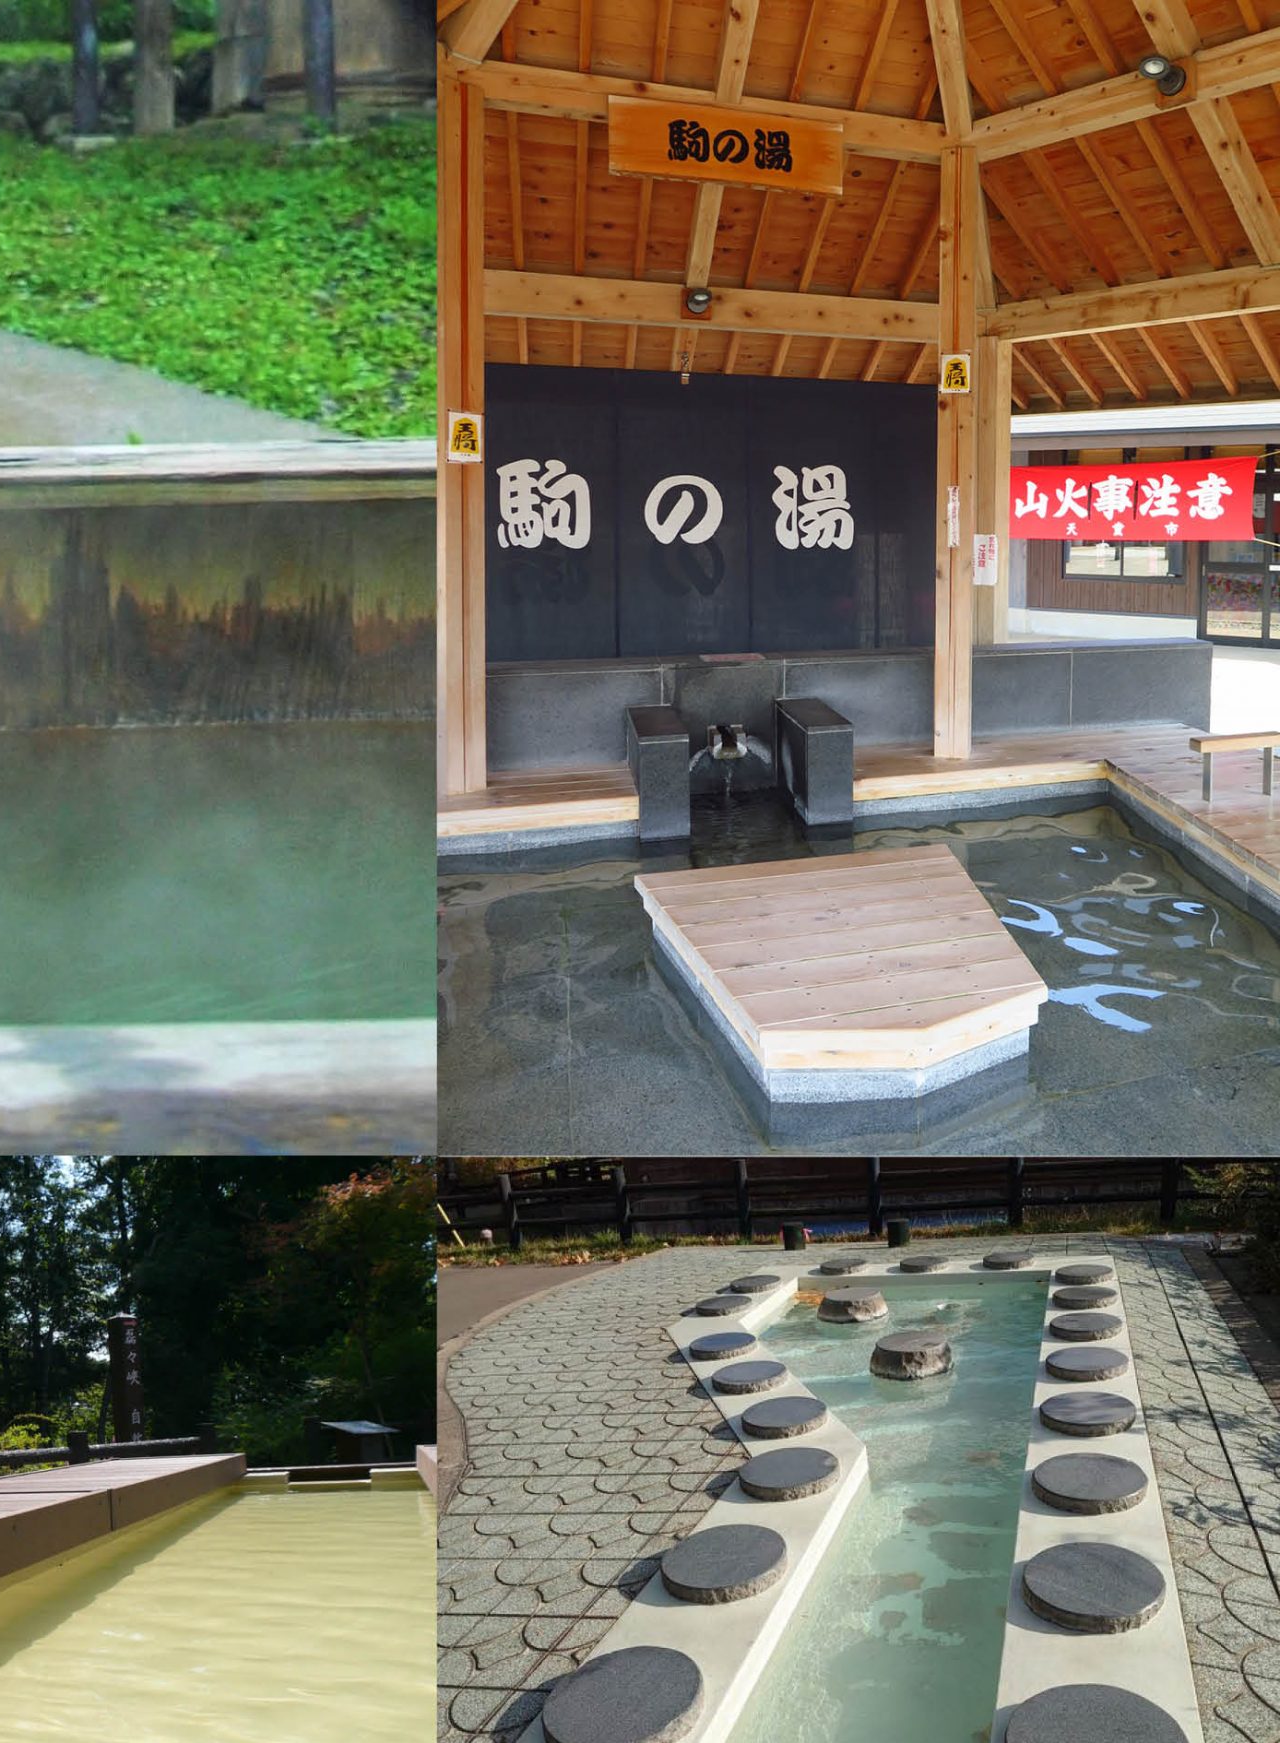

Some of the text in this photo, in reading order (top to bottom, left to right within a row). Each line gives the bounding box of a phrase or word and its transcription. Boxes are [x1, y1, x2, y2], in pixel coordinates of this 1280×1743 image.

[667, 119, 793, 173] 駒の湯
[496, 459, 855, 550] 駒の湯
[1014, 472, 1233, 521] 山火事注意
